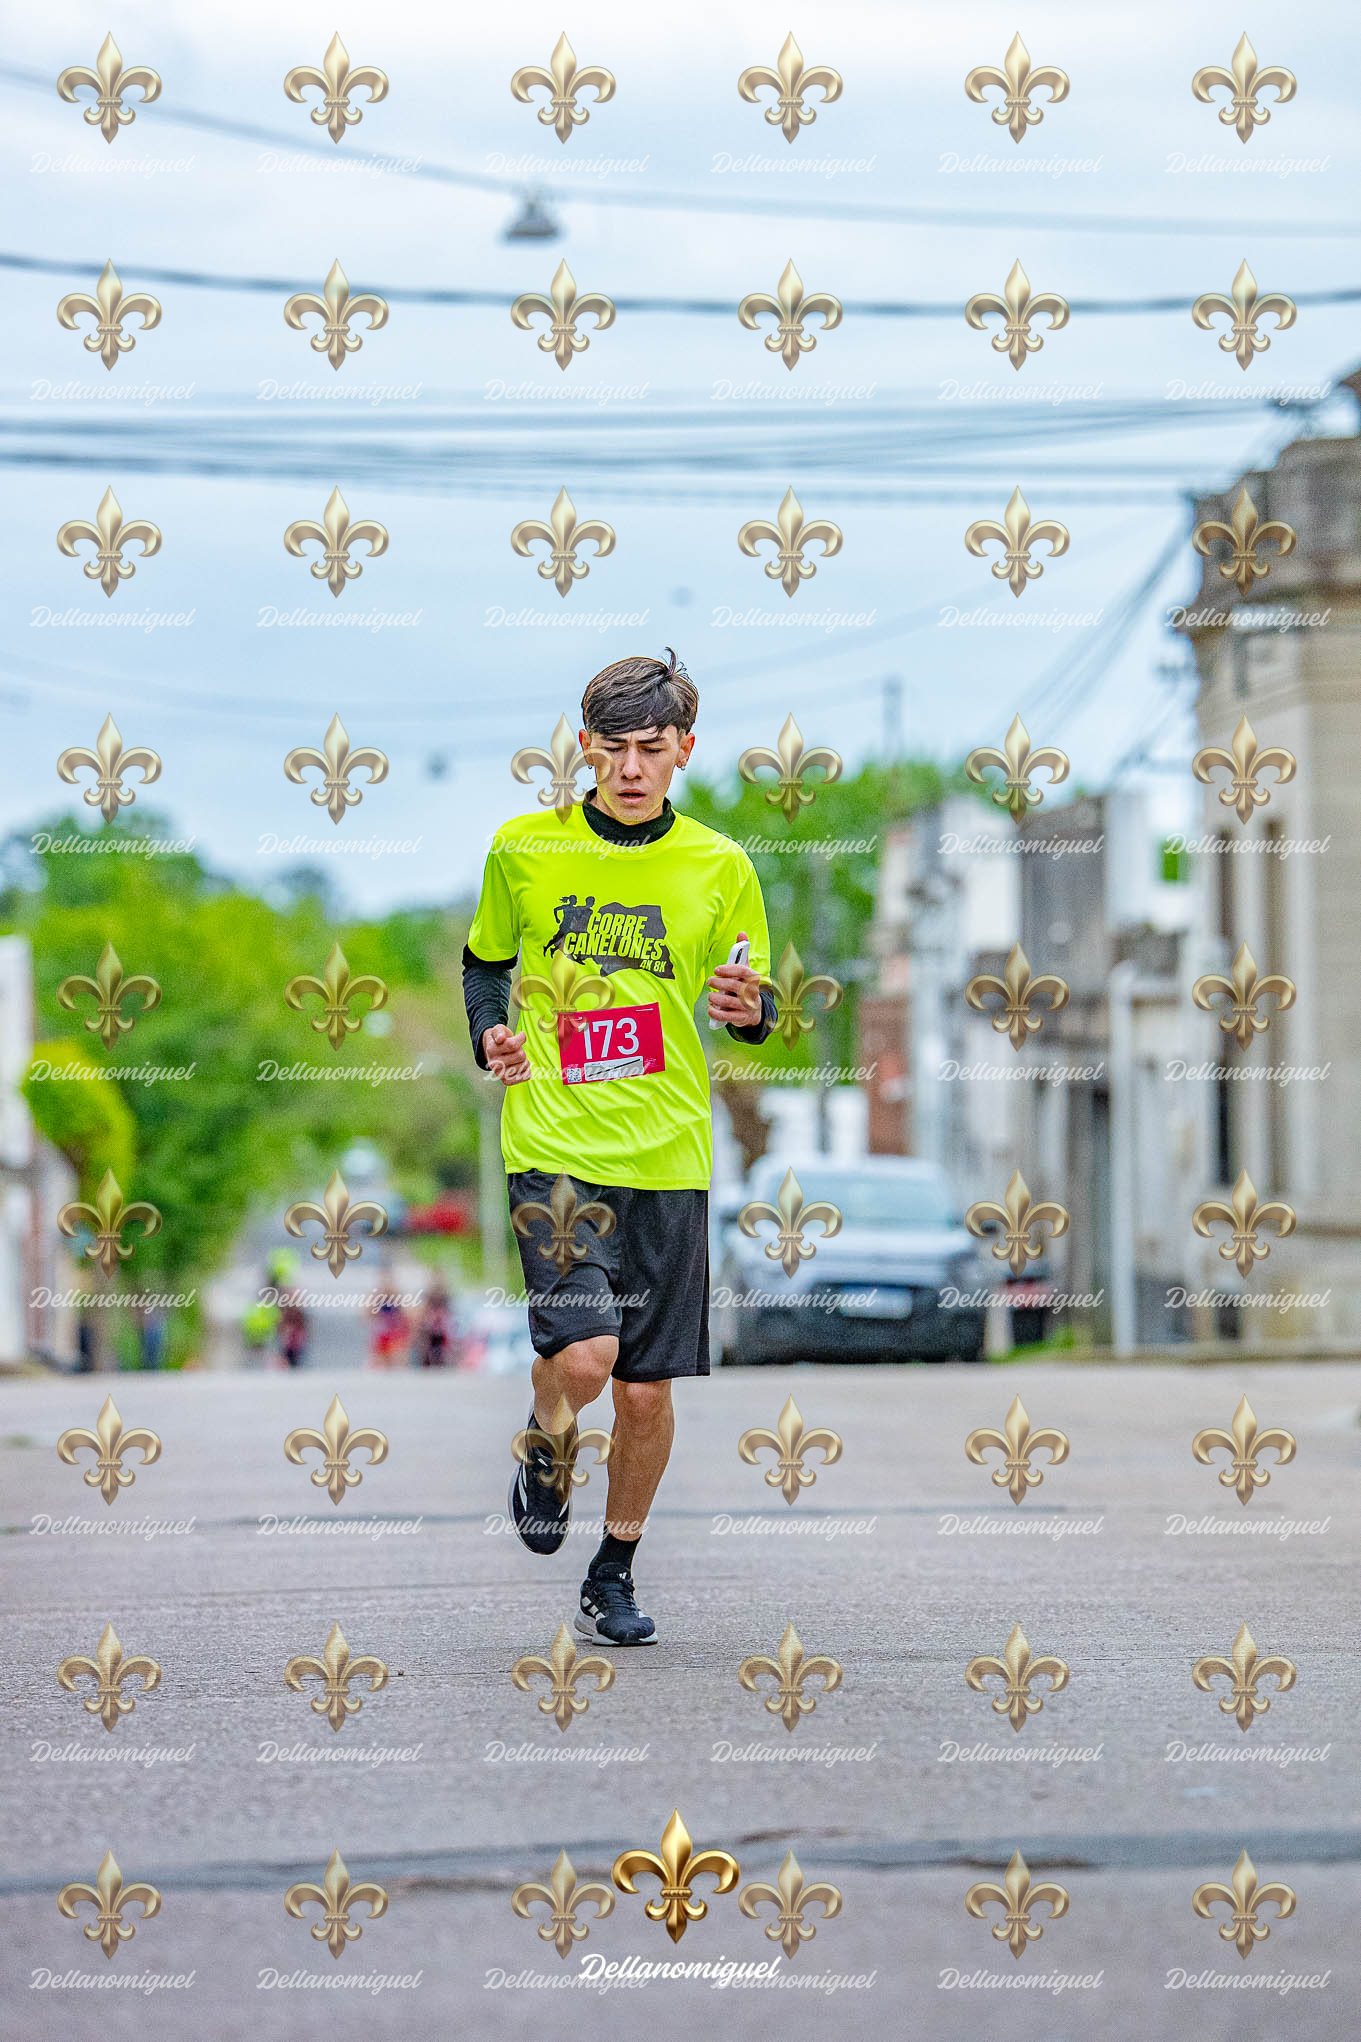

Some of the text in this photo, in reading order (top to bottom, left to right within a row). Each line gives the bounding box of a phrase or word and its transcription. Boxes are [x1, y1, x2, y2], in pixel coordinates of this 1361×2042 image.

[587, 912, 648, 938] CORRE
[563, 932, 666, 960] CANELONES
[640, 959, 667, 973] 4K 8K
[577, 1017, 640, 1060] 173
